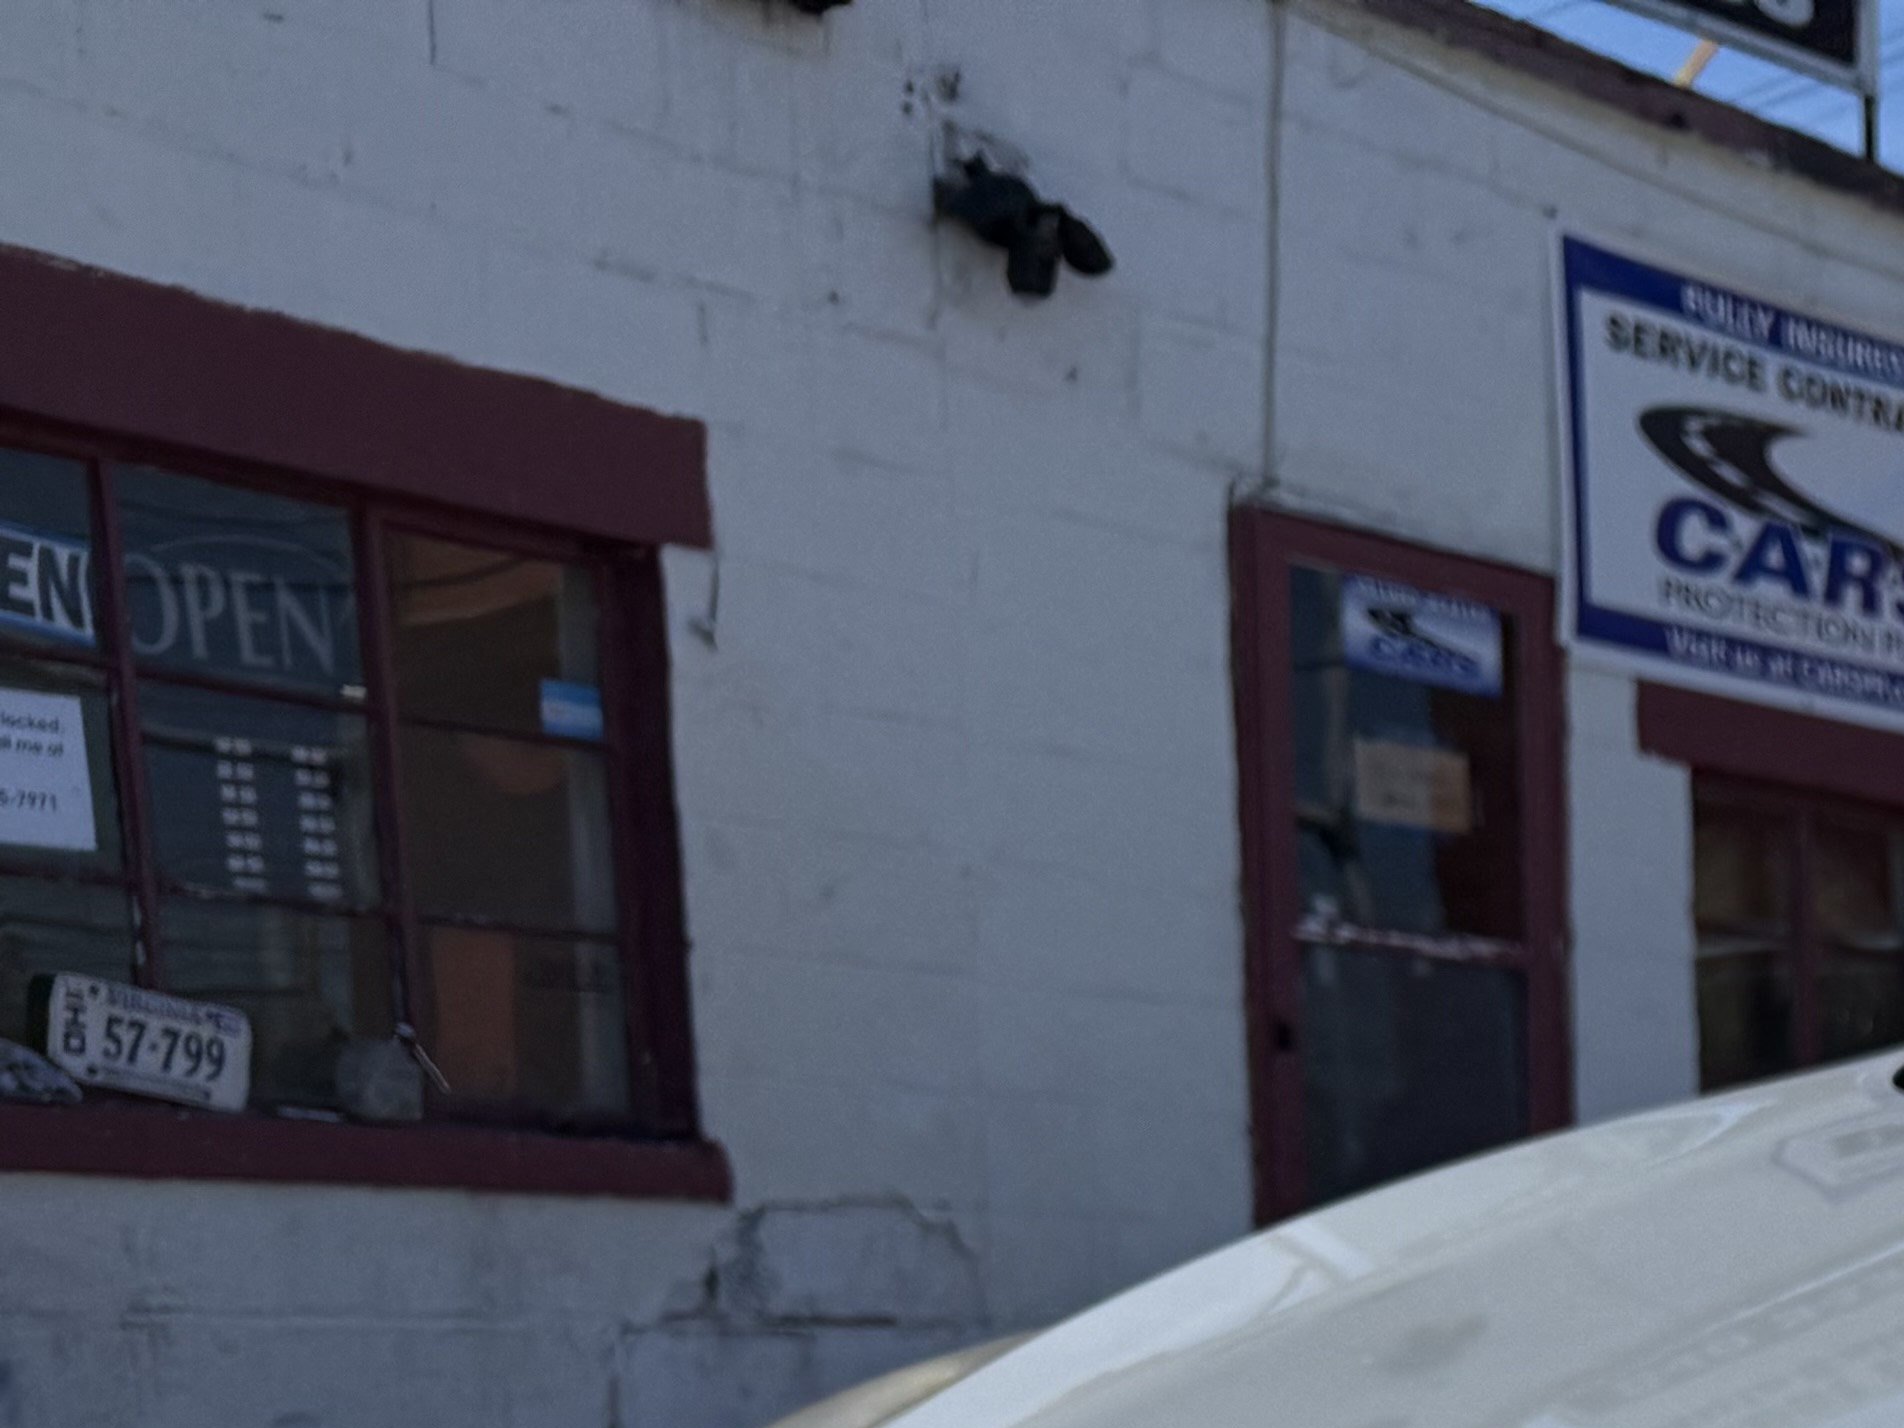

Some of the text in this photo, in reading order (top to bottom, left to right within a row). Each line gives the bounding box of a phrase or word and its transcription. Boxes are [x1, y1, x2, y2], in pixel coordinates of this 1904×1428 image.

[1603, 313, 1768, 393] SERVICE
[125, 553, 336, 678] OPEN
[1661, 577, 1875, 652] PROTECTION
[101, 1014, 226, 1081] 57-799
